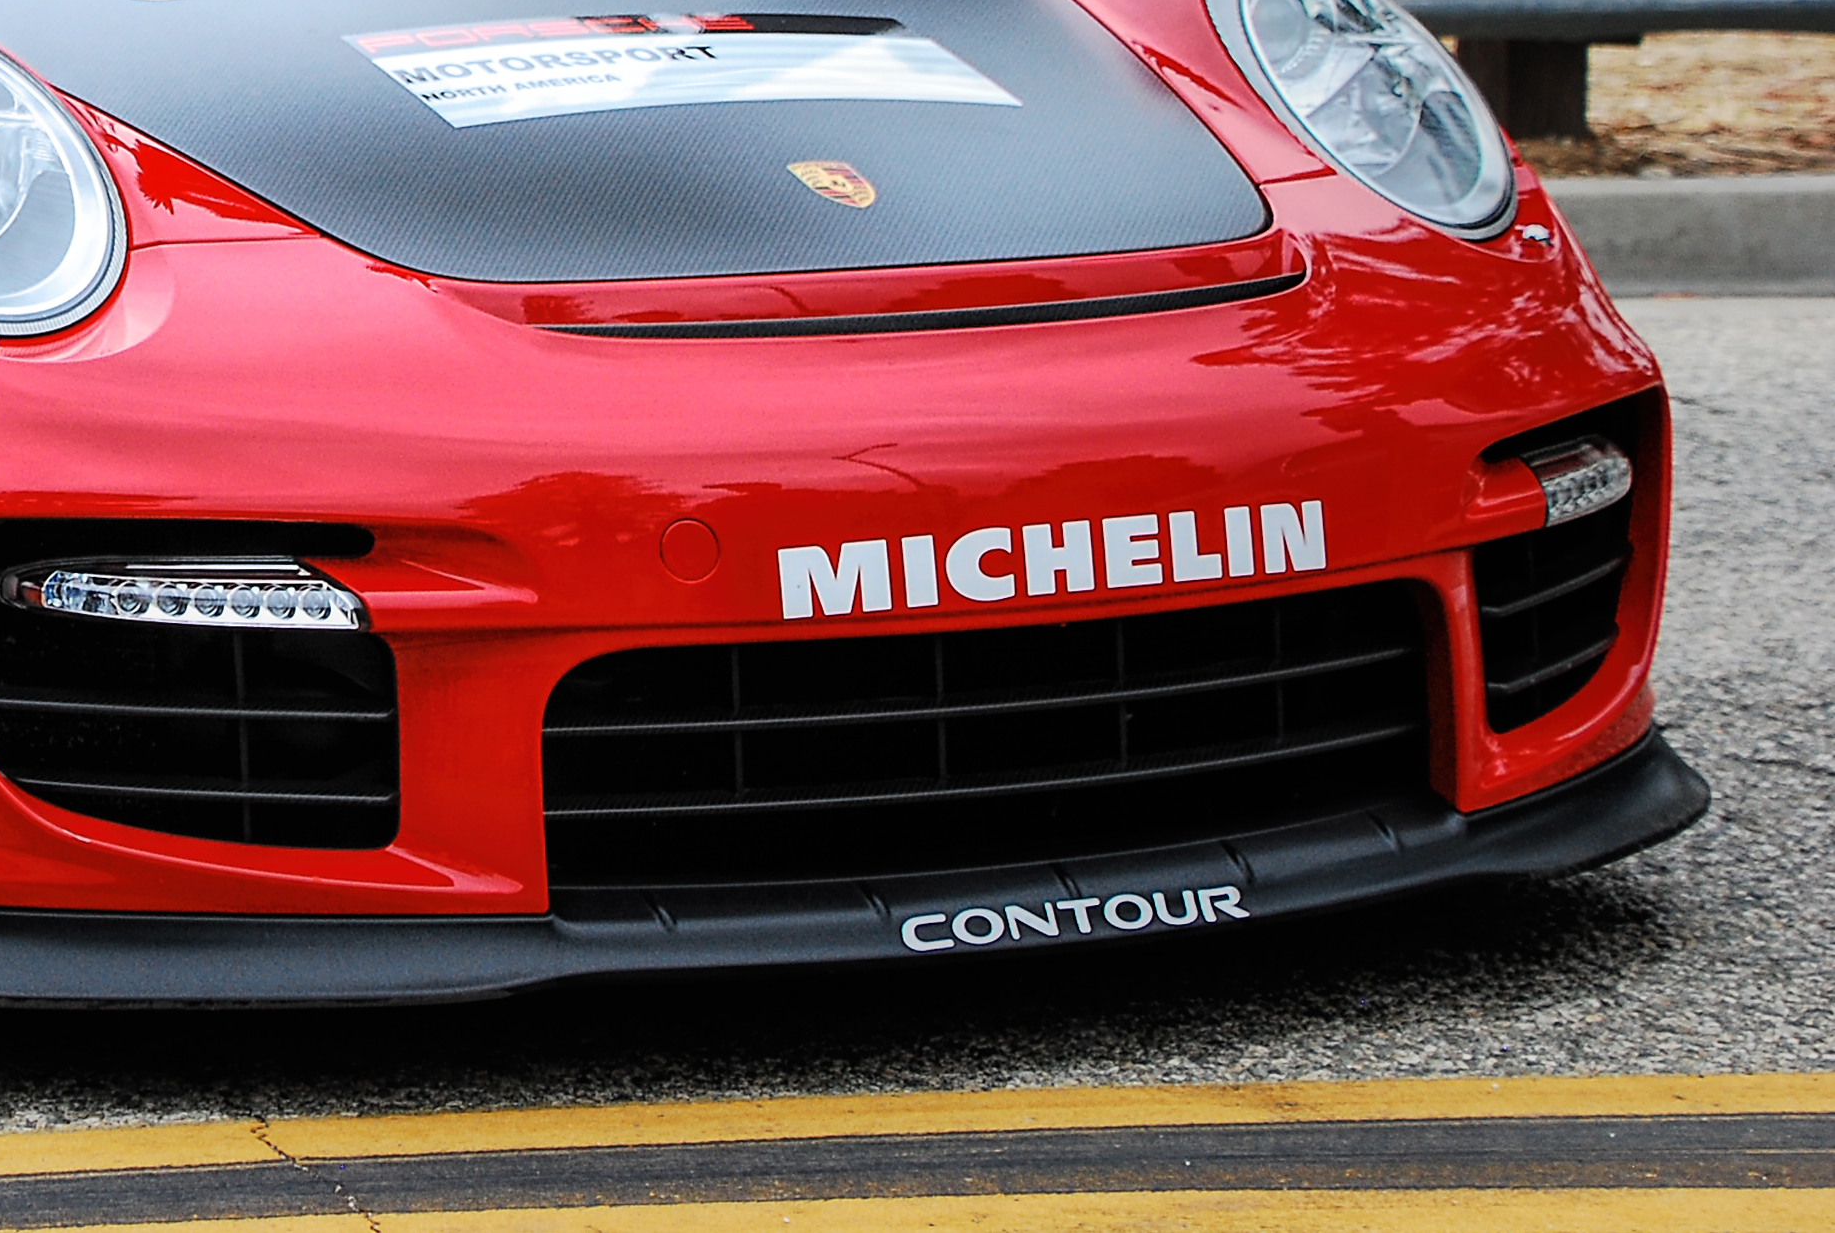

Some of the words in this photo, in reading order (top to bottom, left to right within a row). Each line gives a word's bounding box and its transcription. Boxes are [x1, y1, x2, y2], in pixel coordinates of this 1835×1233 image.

[356, 15, 756, 55] PORSCHE
[393, 45, 717, 85] MOTORSPORT
[421, 84, 507, 104] NORTH
[516, 72, 622, 92] AMERICA
[777, 499, 1327, 620] MICHELIN
[901, 885, 1250, 953] CONTOUR
